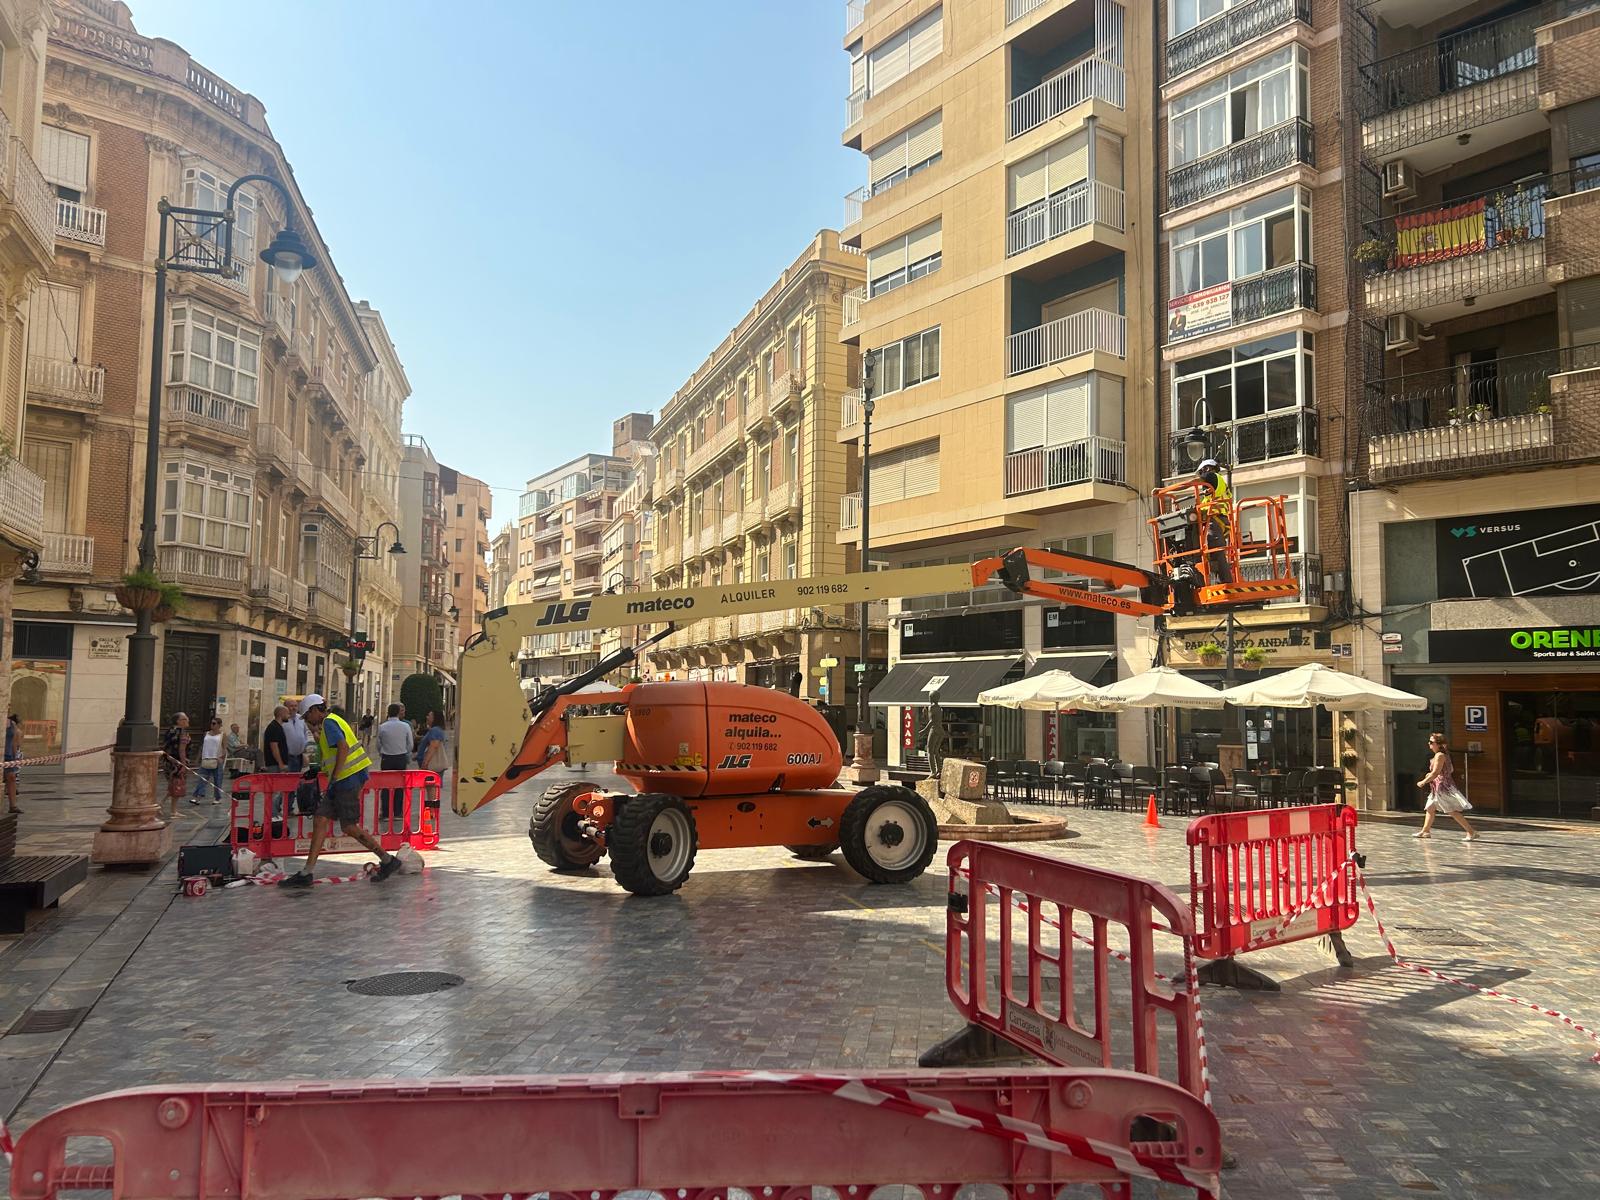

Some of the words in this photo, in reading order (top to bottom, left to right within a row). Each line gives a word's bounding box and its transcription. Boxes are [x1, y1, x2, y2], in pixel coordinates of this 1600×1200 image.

[1480, 524, 1520, 533] VERSUS
[535, 600, 592, 627] JLG
[626, 596, 695, 614] mateco
[720, 588, 776, 603] ALQUILER
[797, 586, 814, 595] 902
[816, 584, 830, 594] 119
[831, 583, 848, 593] 682
[1059, 588, 1131, 609] www.mateco.es
[1048, 613, 1058, 621] EM
[1257, 637, 1310, 647] ANDAZ
[729, 712, 777, 723] mateco
[1470, 709, 1481, 722] P
[725, 727, 781, 740] alquila...
[736, 742, 751, 750] 902
[764, 743, 778, 751] 682
[717, 754, 752, 769] JLG
[786, 753, 822, 765] 600AJ
[1009, 1011, 1041, 1037] Cartagena
